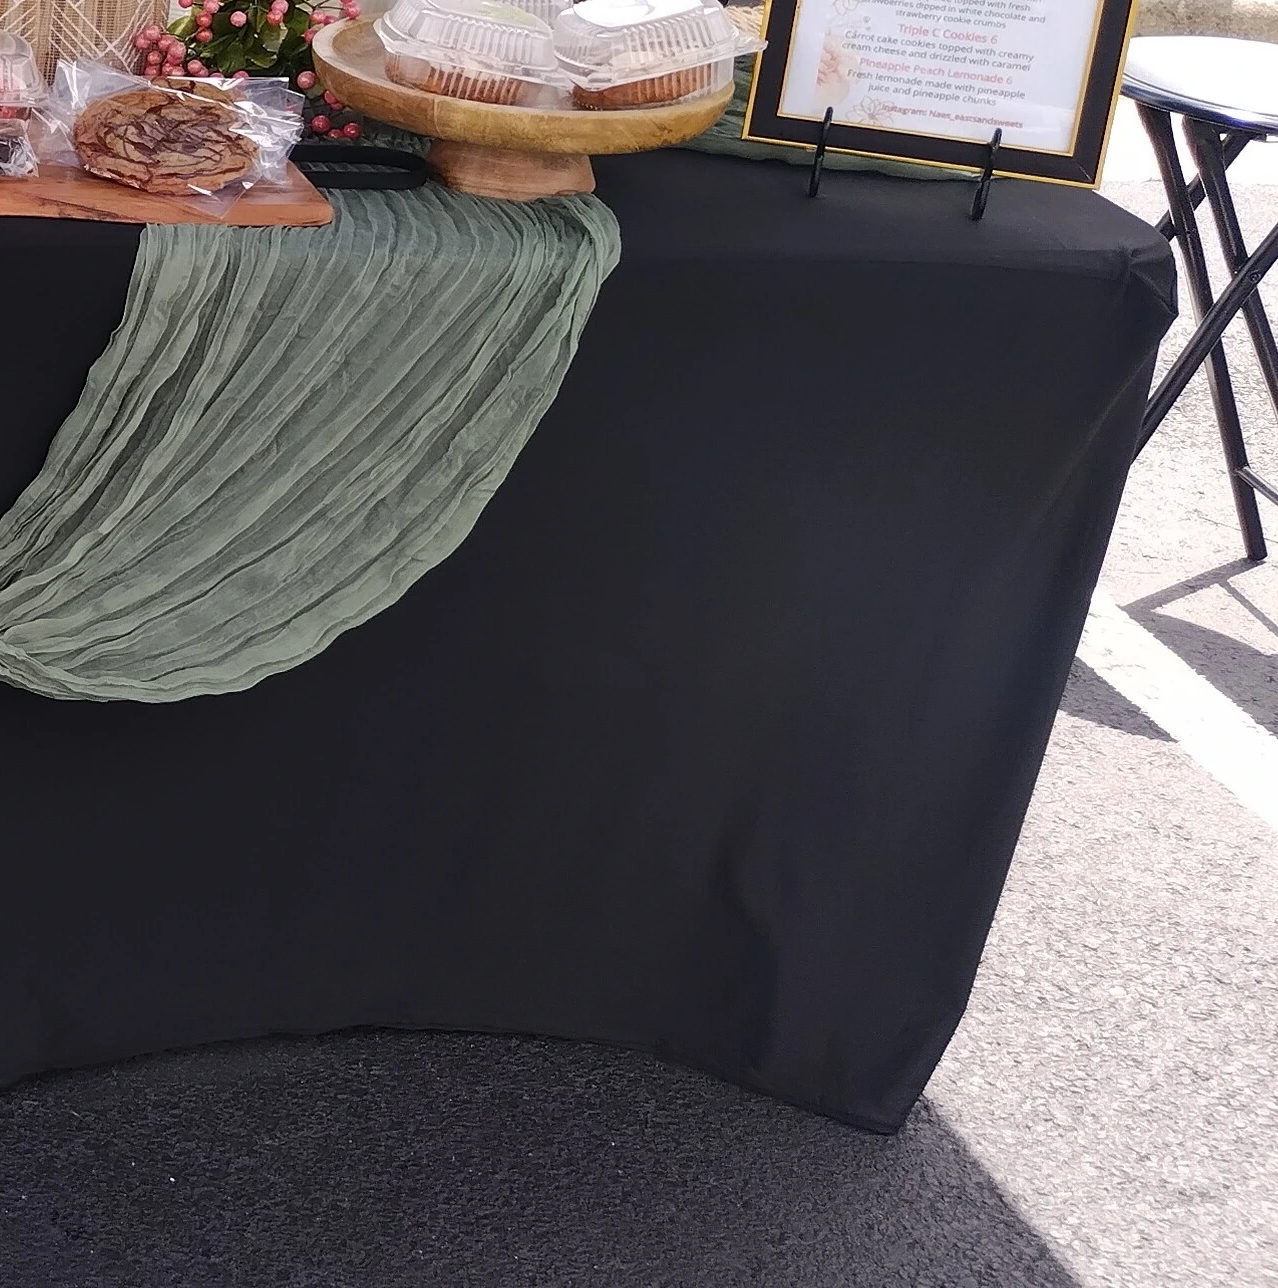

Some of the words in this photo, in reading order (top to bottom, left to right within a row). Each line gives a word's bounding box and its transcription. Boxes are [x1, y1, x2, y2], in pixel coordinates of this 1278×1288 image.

[916, 1, 946, 13] dipped
[958, 6, 982, 15] white
[984, 9, 1026, 20] chocolate
[1028, 14, 1045, 23] and
[986, 0, 1005, 8] with
[1008, 2, 1030, 11] fresh
[894, 8, 941, 22] strawberry
[943, 14, 971, 24] cookie
[973, 18, 1006, 28] crumbs
[898, 24, 929, 38] Triple
[931, 28, 940, 37] C
[942, 29, 987, 43] Cookies
[990, 35, 997, 44] 6
[841, 41, 871, 51] cream
[873, 45, 906, 56] cheese
[908, 49, 927, 58] and
[928, 52, 966, 63] drizzled
[968, 56, 989, 66] with
[991, 59, 1031, 71] caramel
[844, 30, 875, 41] Carrot
[876, 34, 898, 44] cake
[900, 38, 936, 49] cookies
[937, 42, 973, 55] topped
[974, 47, 995, 56] with
[997, 50, 1034, 63] creamy
[858, 57, 911, 74] Pineapple
[913, 64, 945, 76] Peach
[947, 68, 1003, 83] Lemonade
[1005, 76, 1013, 84] 6
[847, 69, 872, 79] Fresh
[875, 72, 922, 86] lemonade
[924, 79, 951, 89] made
[953, 83, 975, 92] with
[976, 86, 1025, 100] pineapple
[867, 82, 890, 93] juice
[892, 86, 911, 95] and
[912, 88, 960, 103] pineapple
[962, 95, 996, 106] chunks
